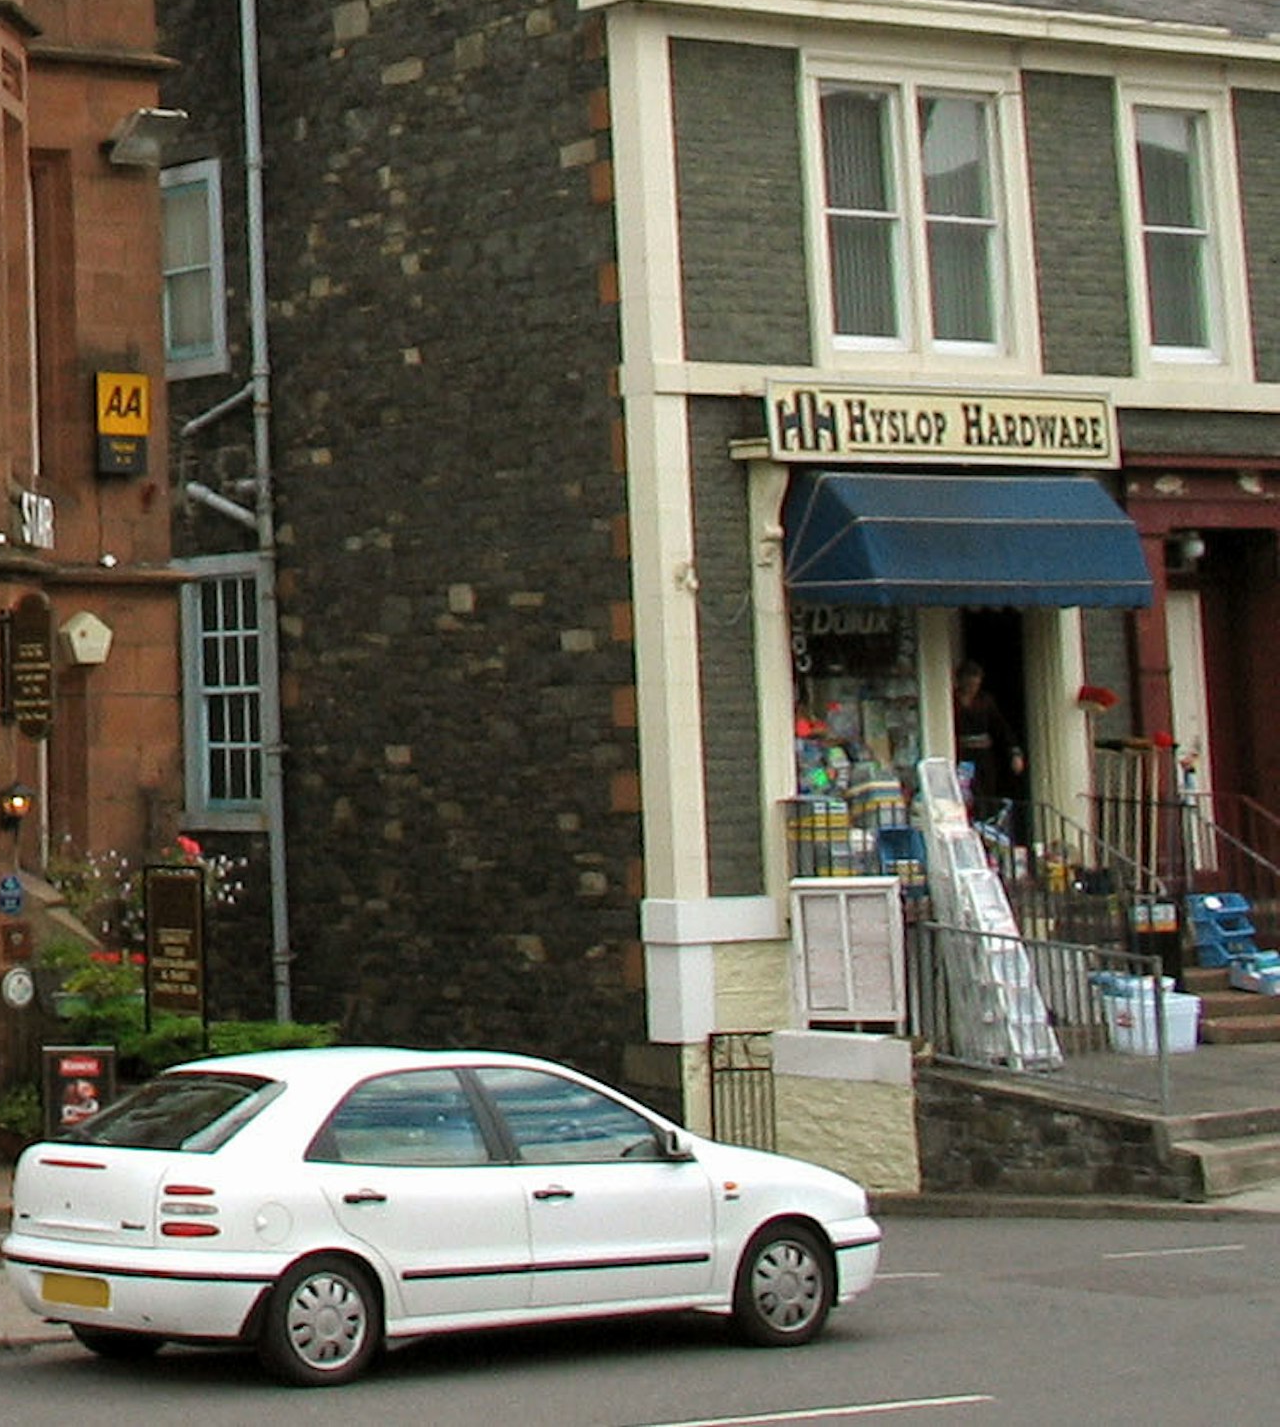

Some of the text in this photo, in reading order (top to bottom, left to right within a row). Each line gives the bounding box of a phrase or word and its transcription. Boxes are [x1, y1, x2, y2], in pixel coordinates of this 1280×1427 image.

[104, 386, 142, 419] AA
[844, 399, 1104, 450] HYSLOP HARDWARE
[812, 606, 888, 634] Dulux
